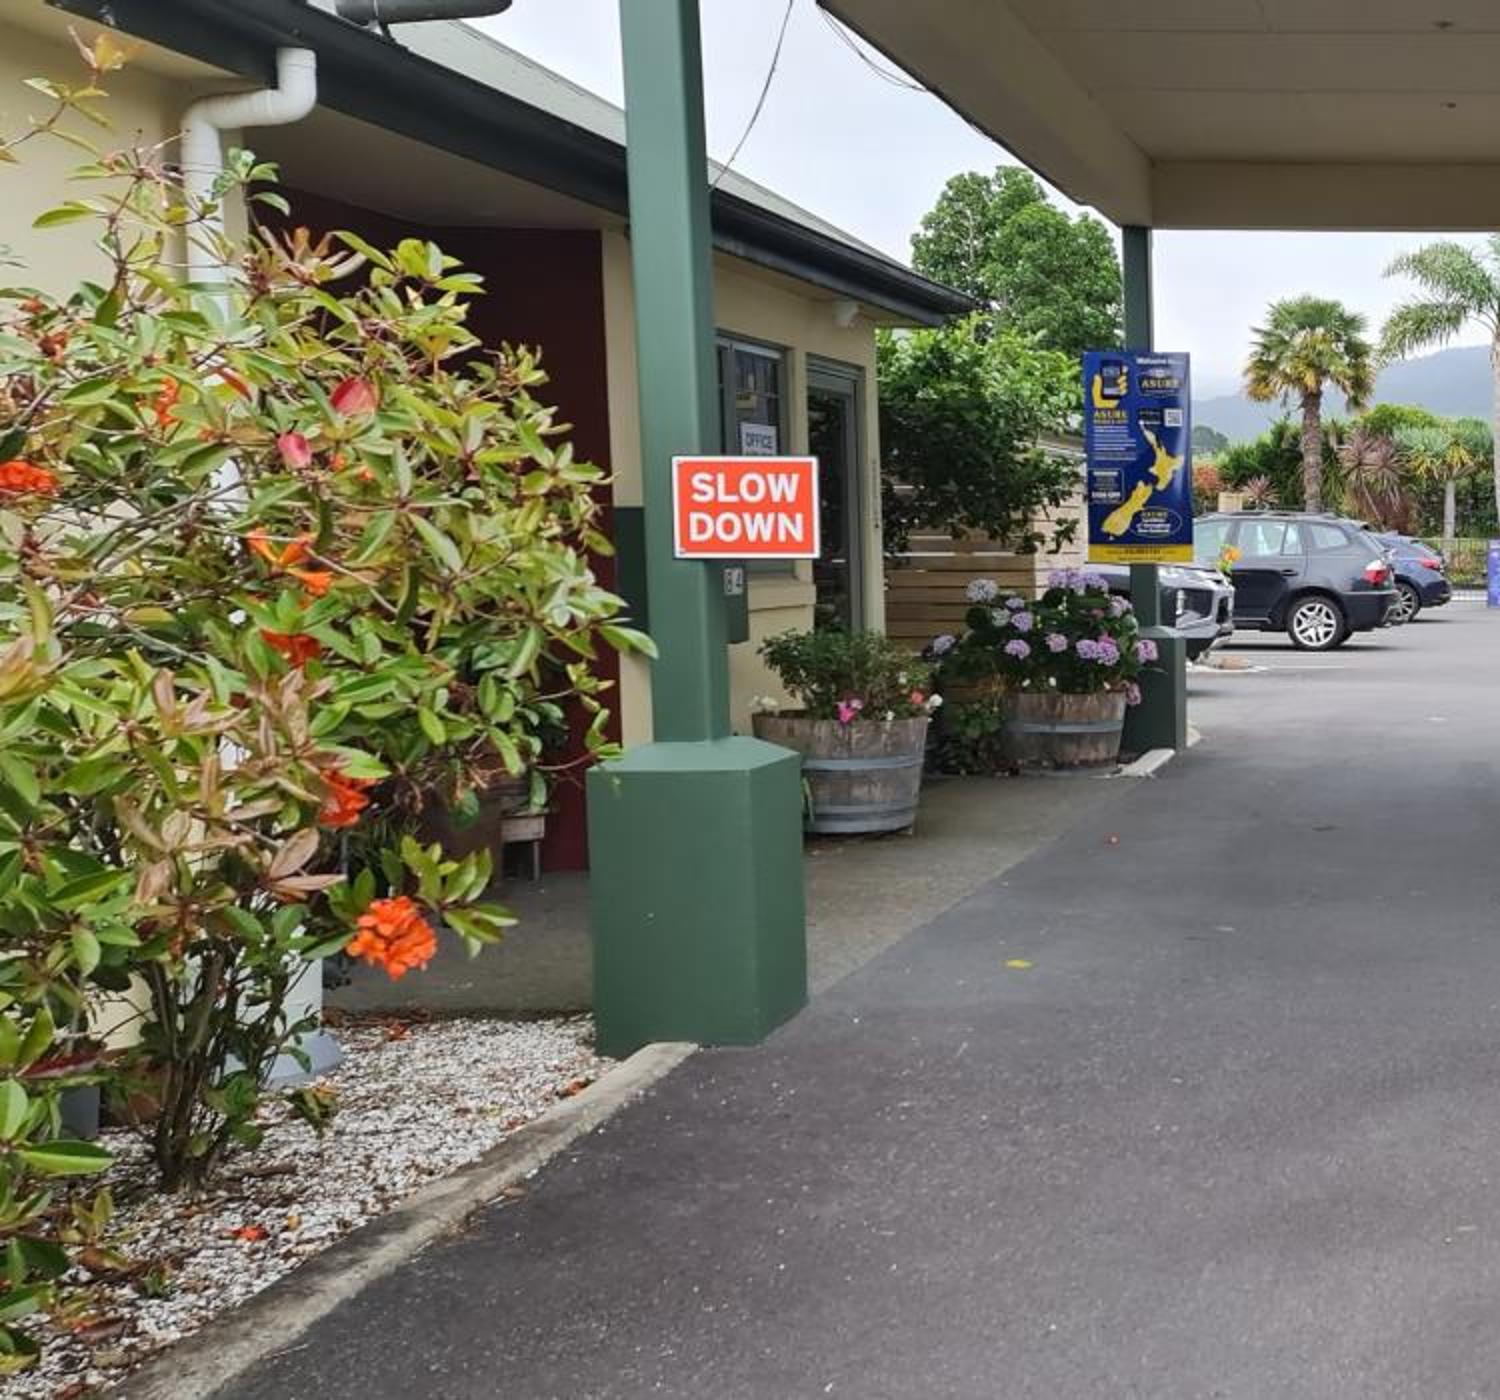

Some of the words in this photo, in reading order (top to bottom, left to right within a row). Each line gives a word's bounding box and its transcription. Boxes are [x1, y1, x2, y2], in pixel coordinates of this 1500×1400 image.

[1142, 379, 1181, 389] ASURE
[745, 431, 773, 449] OFFICE
[691, 472, 800, 503] SLOW
[689, 512, 804, 543] DOWN
